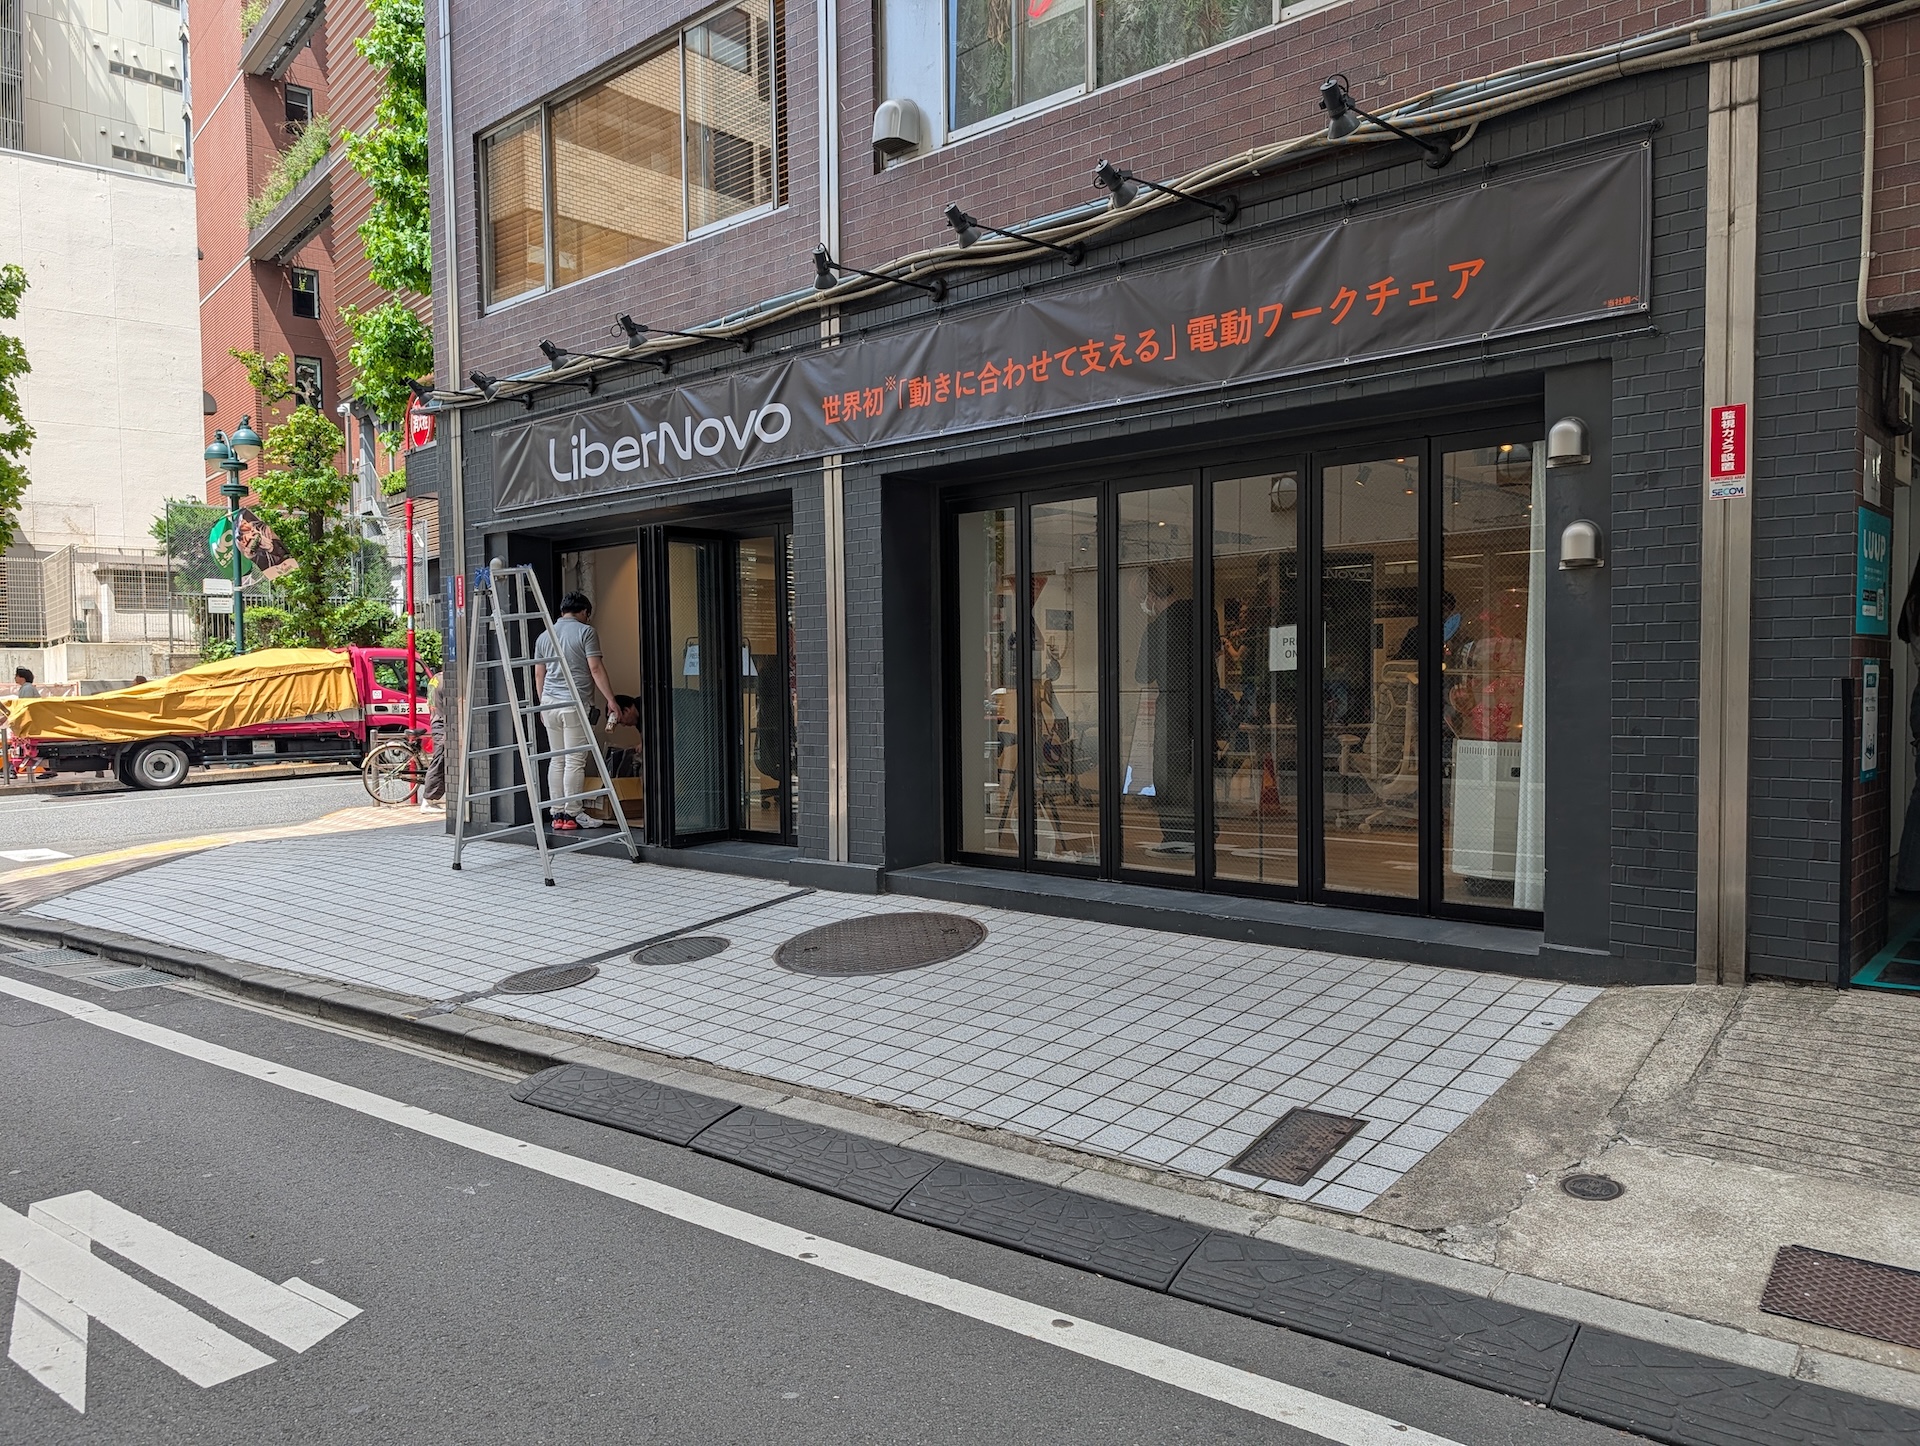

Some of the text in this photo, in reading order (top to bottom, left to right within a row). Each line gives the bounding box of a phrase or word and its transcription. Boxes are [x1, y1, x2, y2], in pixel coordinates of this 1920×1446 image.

[822, 258, 1485, 425] 世界初※「動きに合わせて支える」電動ワークチェア
[549, 403, 792, 482] LiberNovo
[1720, 410, 1736, 472] 監視カメラ設置
[1712, 486, 1744, 497] SECOM
[1864, 529, 1886, 563] LUUP
